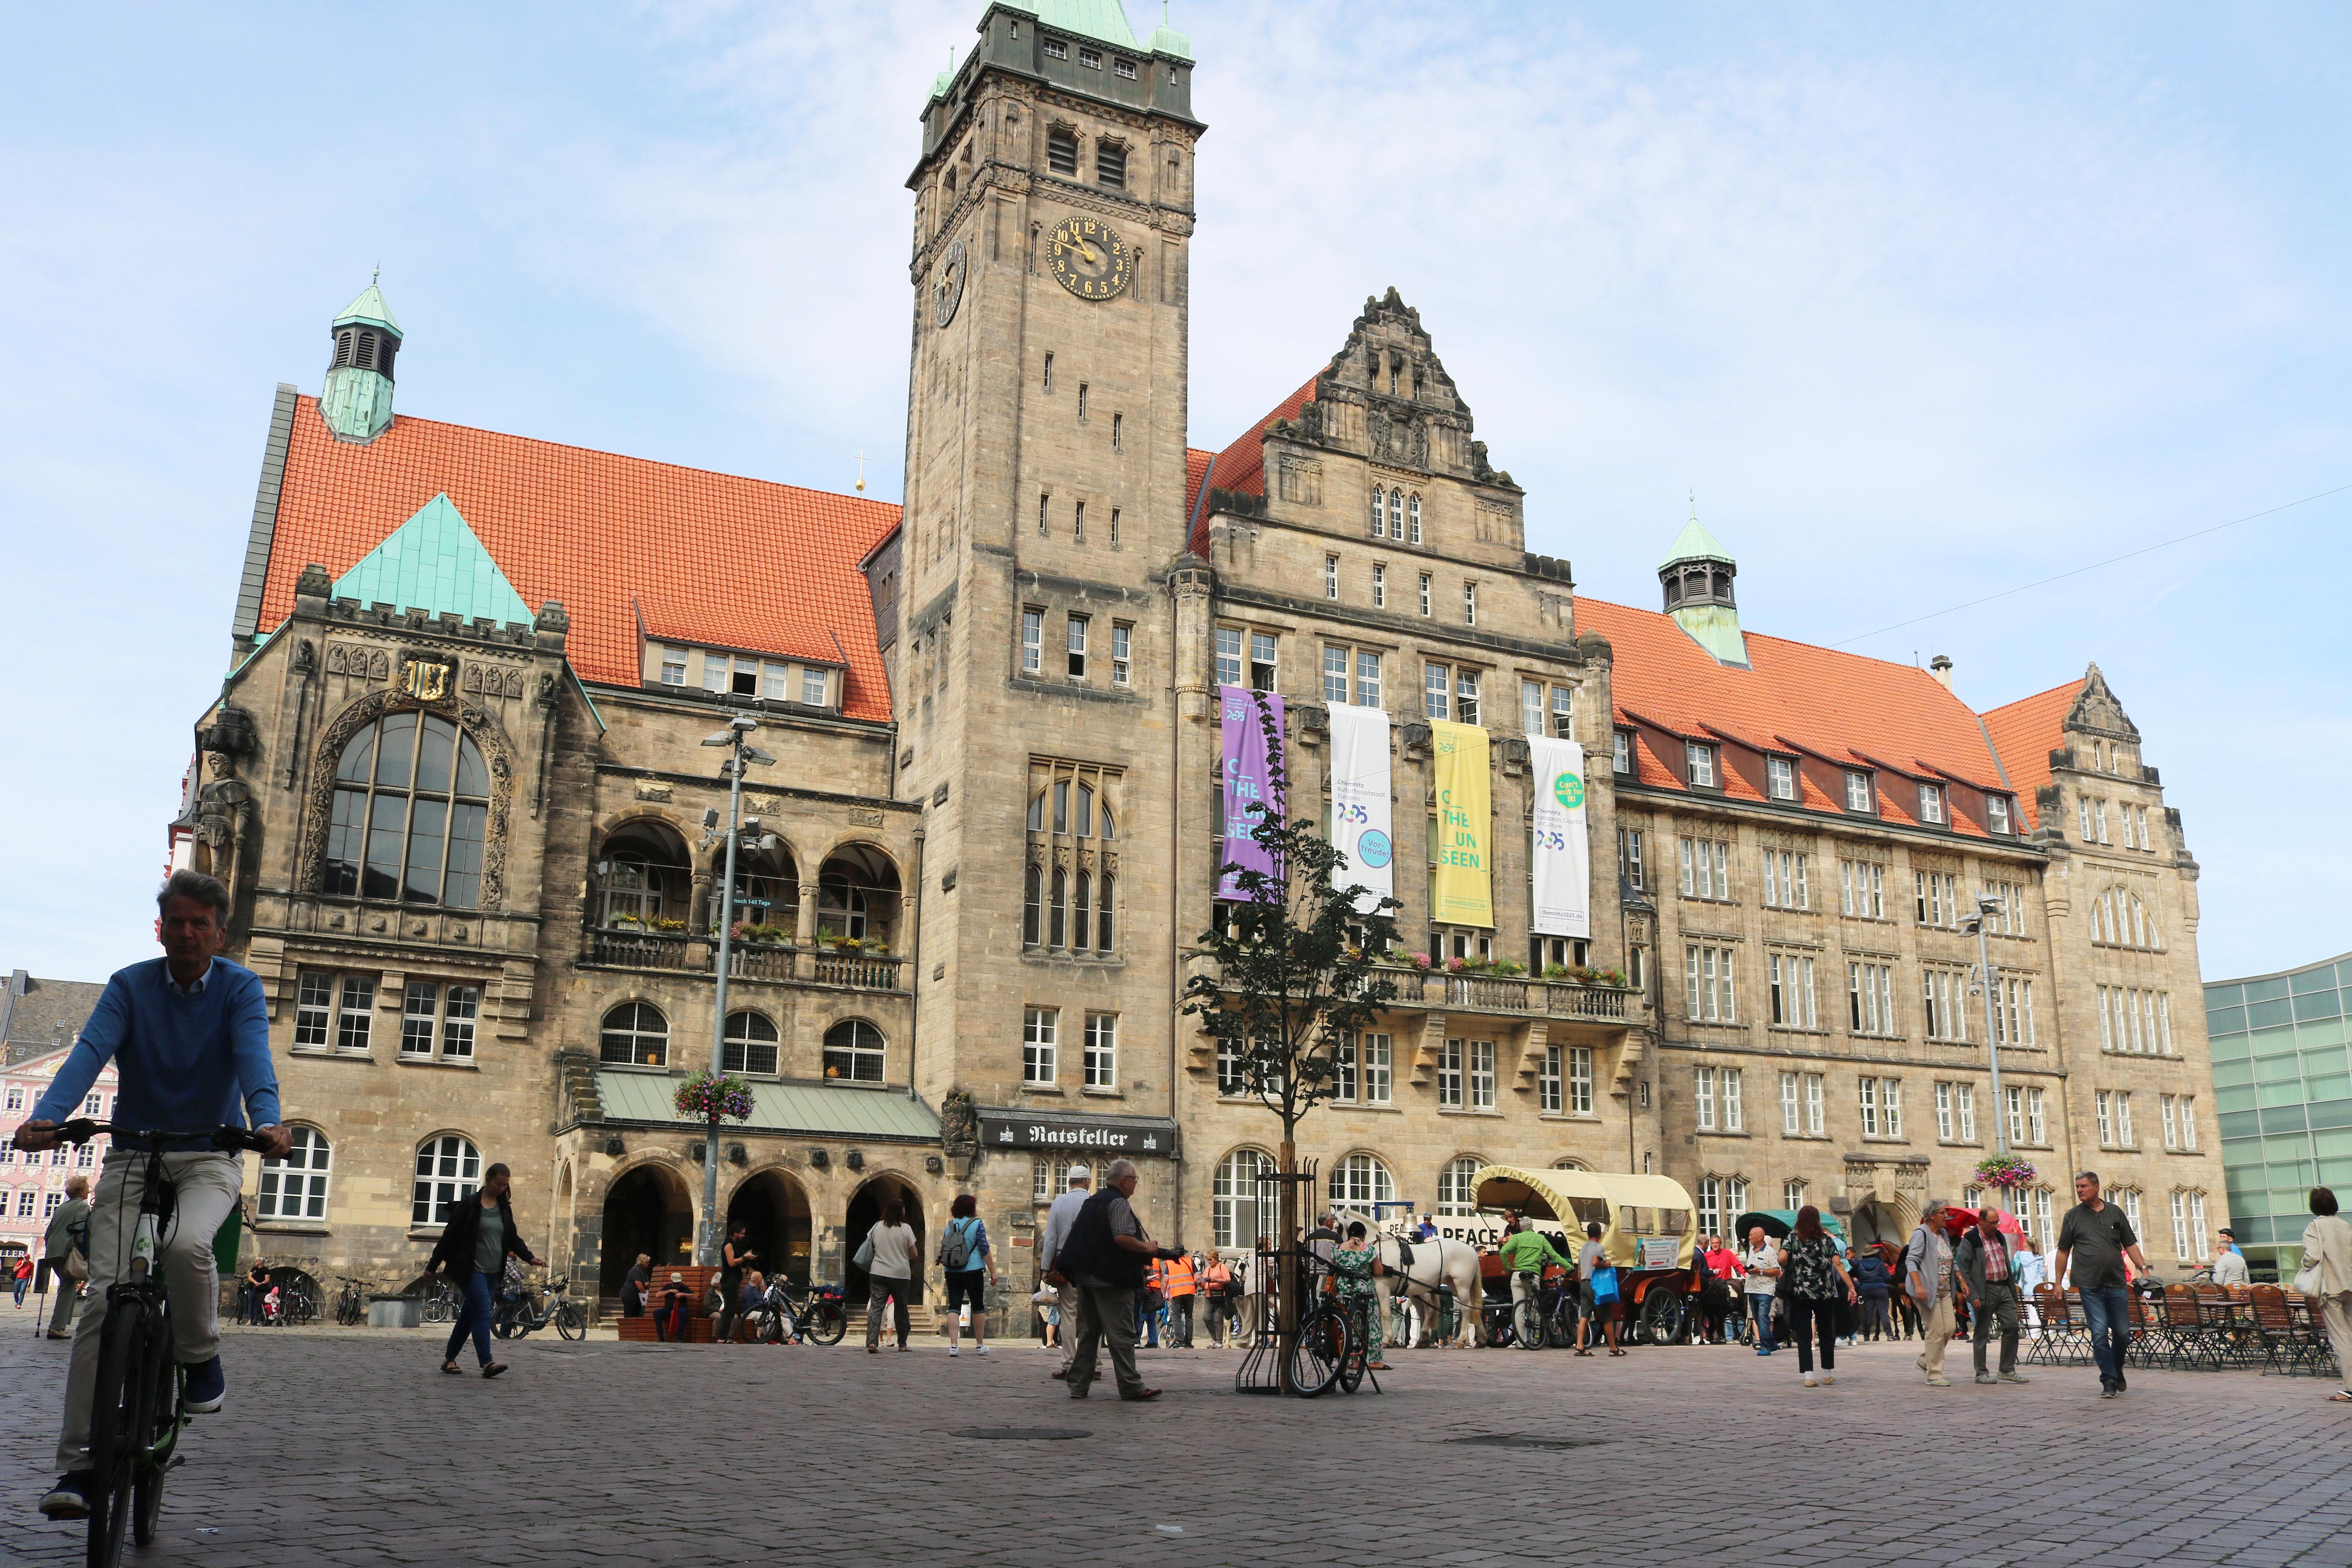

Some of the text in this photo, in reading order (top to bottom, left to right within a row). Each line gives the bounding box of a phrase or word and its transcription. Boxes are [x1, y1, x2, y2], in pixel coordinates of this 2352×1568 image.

[1069, 221, 1079, 234] 11
[1085, 221, 1096, 234] 12
[1058, 229, 1068, 242] 10
[1103, 230, 1108, 241] 1
[948, 247, 953, 261] 12
[955, 244, 957, 255] 1
[958, 248, 962, 261] 2
[1054, 243, 1062, 256] 9
[1113, 243, 1120, 254] 2
[958, 262, 962, 274] 3
[1058, 260, 1065, 272] 8
[1116, 259, 1123, 271] 3
[1069, 273, 1077, 286] 7
[1111, 274, 1119, 285] 4
[1085, 281, 1092, 293] 6
[1100, 281, 1107, 293] 5
[1229, 779, 1260, 799] THE
[1338, 779, 1364, 788] Chemnitz
[1338, 786, 1385, 798] Kulturhauptstadt
[1338, 793, 1360, 801] Europas
[1537, 808, 1561, 816] Chemnitz
[1443, 809, 1470, 828] THE
[1368, 839, 1384, 848] Vor-
[1361, 846, 1389, 858] freude!
[1443, 899, 1486, 908] chemnitz2025.de
[1541, 910, 1583, 919] chemnitz2025.de
[1029, 1126, 1128, 1147] Ratskeller
[1443, 1228, 1498, 1245] PEACE
